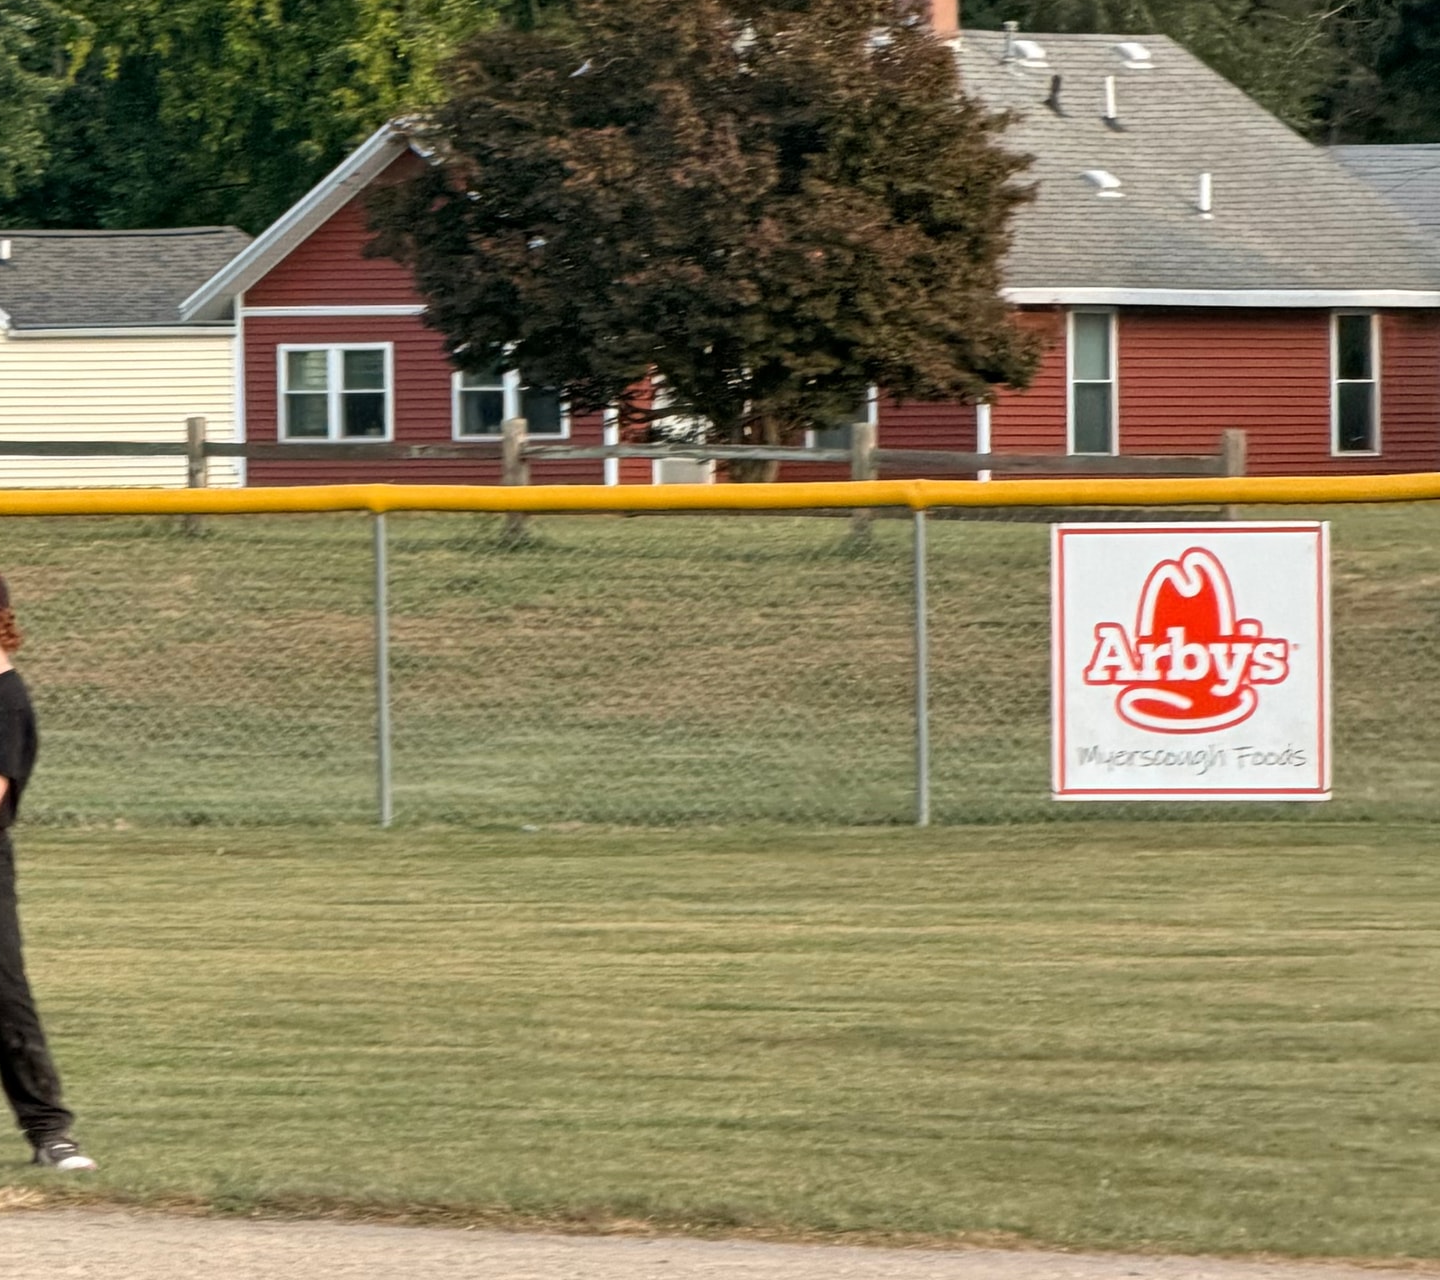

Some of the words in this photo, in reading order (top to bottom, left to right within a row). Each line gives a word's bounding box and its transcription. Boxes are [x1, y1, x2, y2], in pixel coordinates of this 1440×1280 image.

[1085, 622, 1287, 697] Arby's
[1075, 744, 1226, 776] Myerscough
[1232, 743, 1307, 770] Foods
